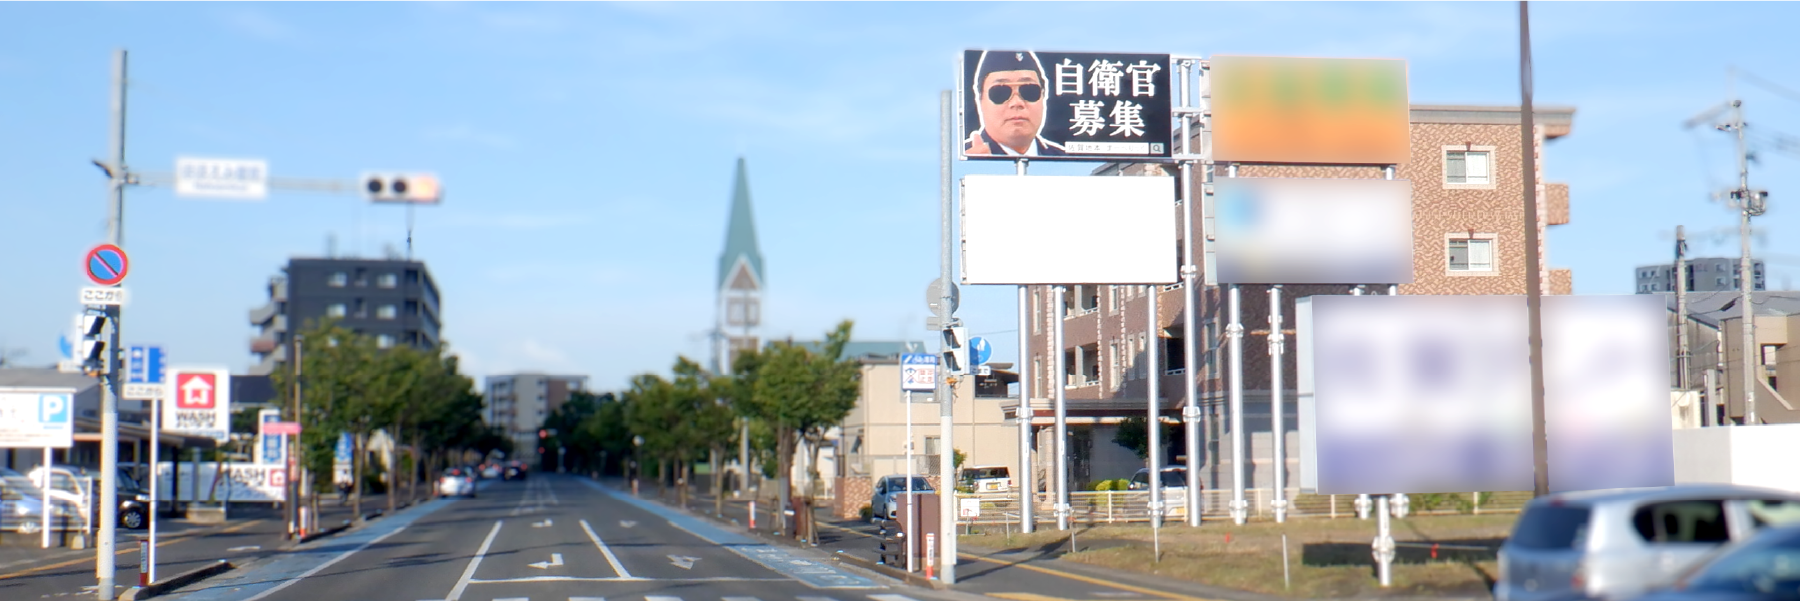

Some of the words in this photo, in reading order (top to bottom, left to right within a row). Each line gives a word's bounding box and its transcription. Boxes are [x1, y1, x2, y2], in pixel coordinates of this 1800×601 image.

[1055, 58, 1161, 96] 自衛官
[1069, 100, 1145, 136] 募集
[175, 411, 216, 421] WASH
